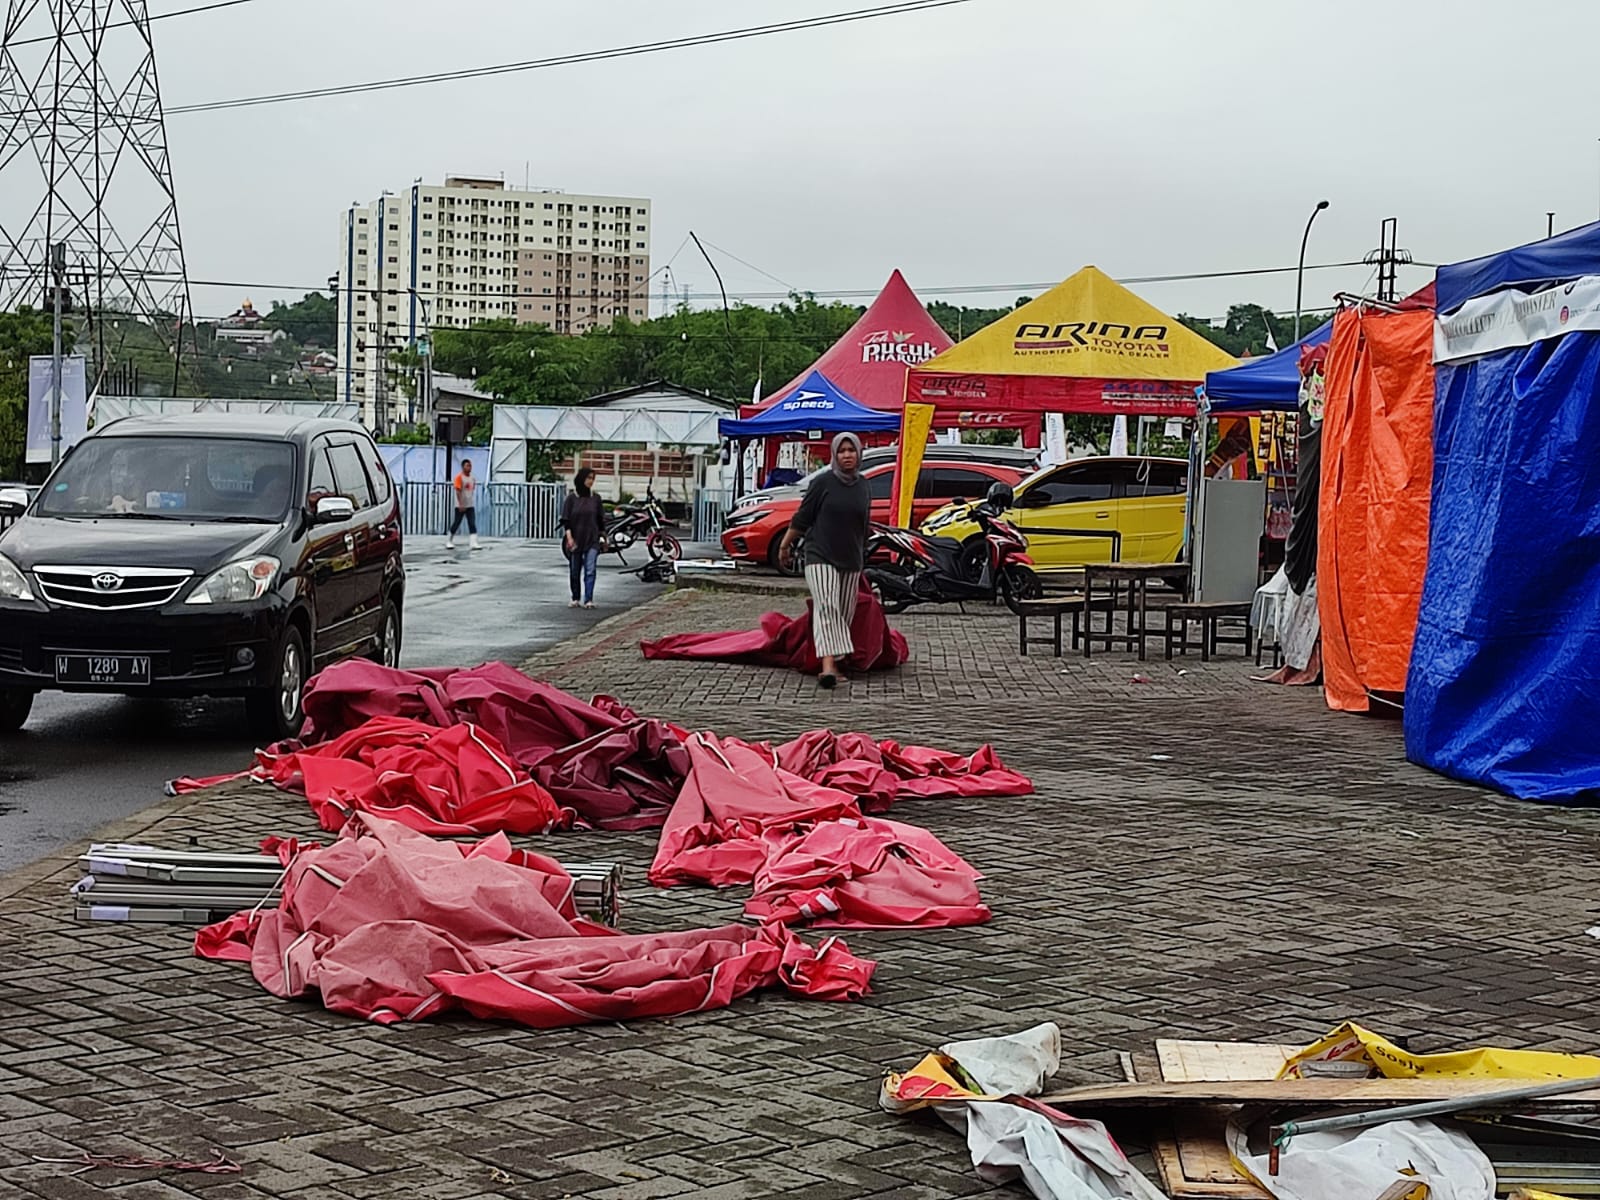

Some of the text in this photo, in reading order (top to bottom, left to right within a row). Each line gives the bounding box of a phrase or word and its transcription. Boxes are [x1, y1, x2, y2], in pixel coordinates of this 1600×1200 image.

[1015, 321, 1168, 345] ARINA
[1014, 347, 1080, 356] AUTHORIZED
[1085, 345, 1125, 356] TOYOTA
[1092, 337, 1156, 352] TOYOTA
[783, 400, 835, 411] speeds
[58, 657, 147, 675] W 1280 AY
